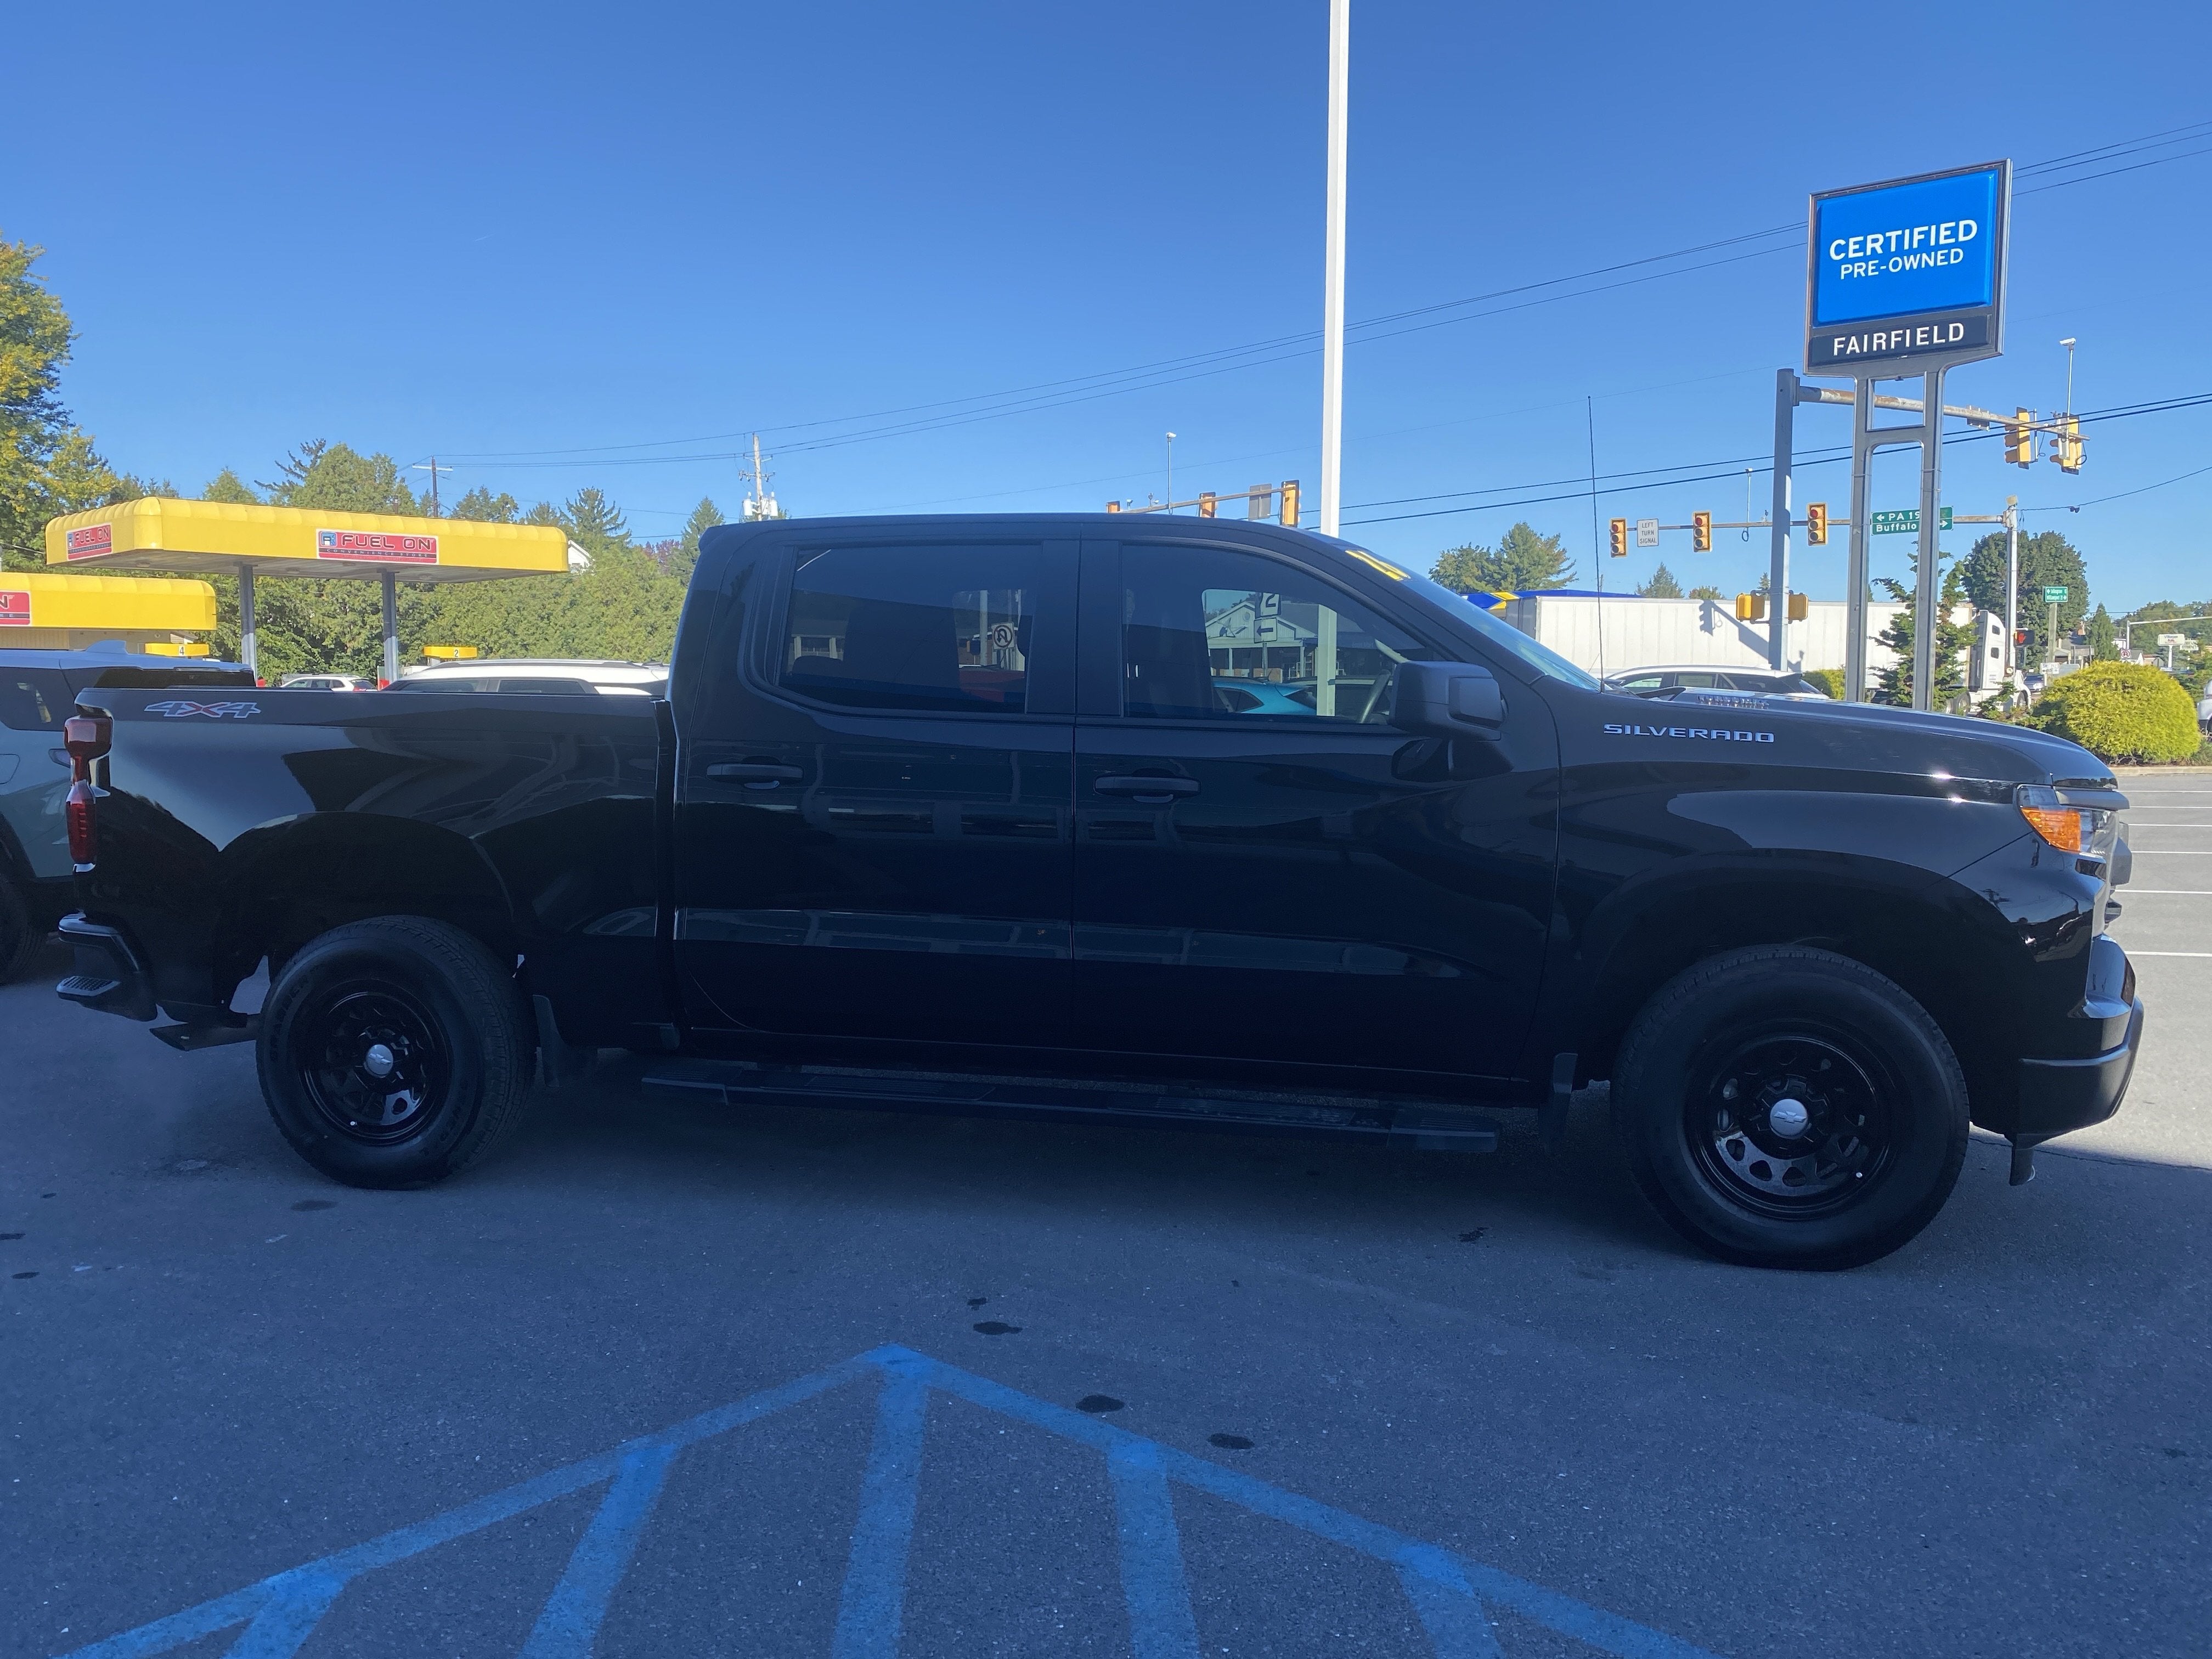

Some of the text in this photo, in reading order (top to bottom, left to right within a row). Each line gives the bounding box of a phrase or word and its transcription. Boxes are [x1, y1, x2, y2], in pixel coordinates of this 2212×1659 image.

[1830, 219, 1978, 261] CERTIFIED
[1840, 248, 1964, 280] PRE-OWNED
[1833, 323, 1965, 356] FAIRFIELD
[1888, 511, 1920, 521] PA 19
[1876, 522, 1917, 532] Buffalo
[75, 527, 110, 545] FUEL ON
[341, 534, 431, 551] FUEL ON
[179, 646, 185, 656] 4
[454, 649, 459, 658] 2
[1604, 723, 1775, 743] SILVERADO
